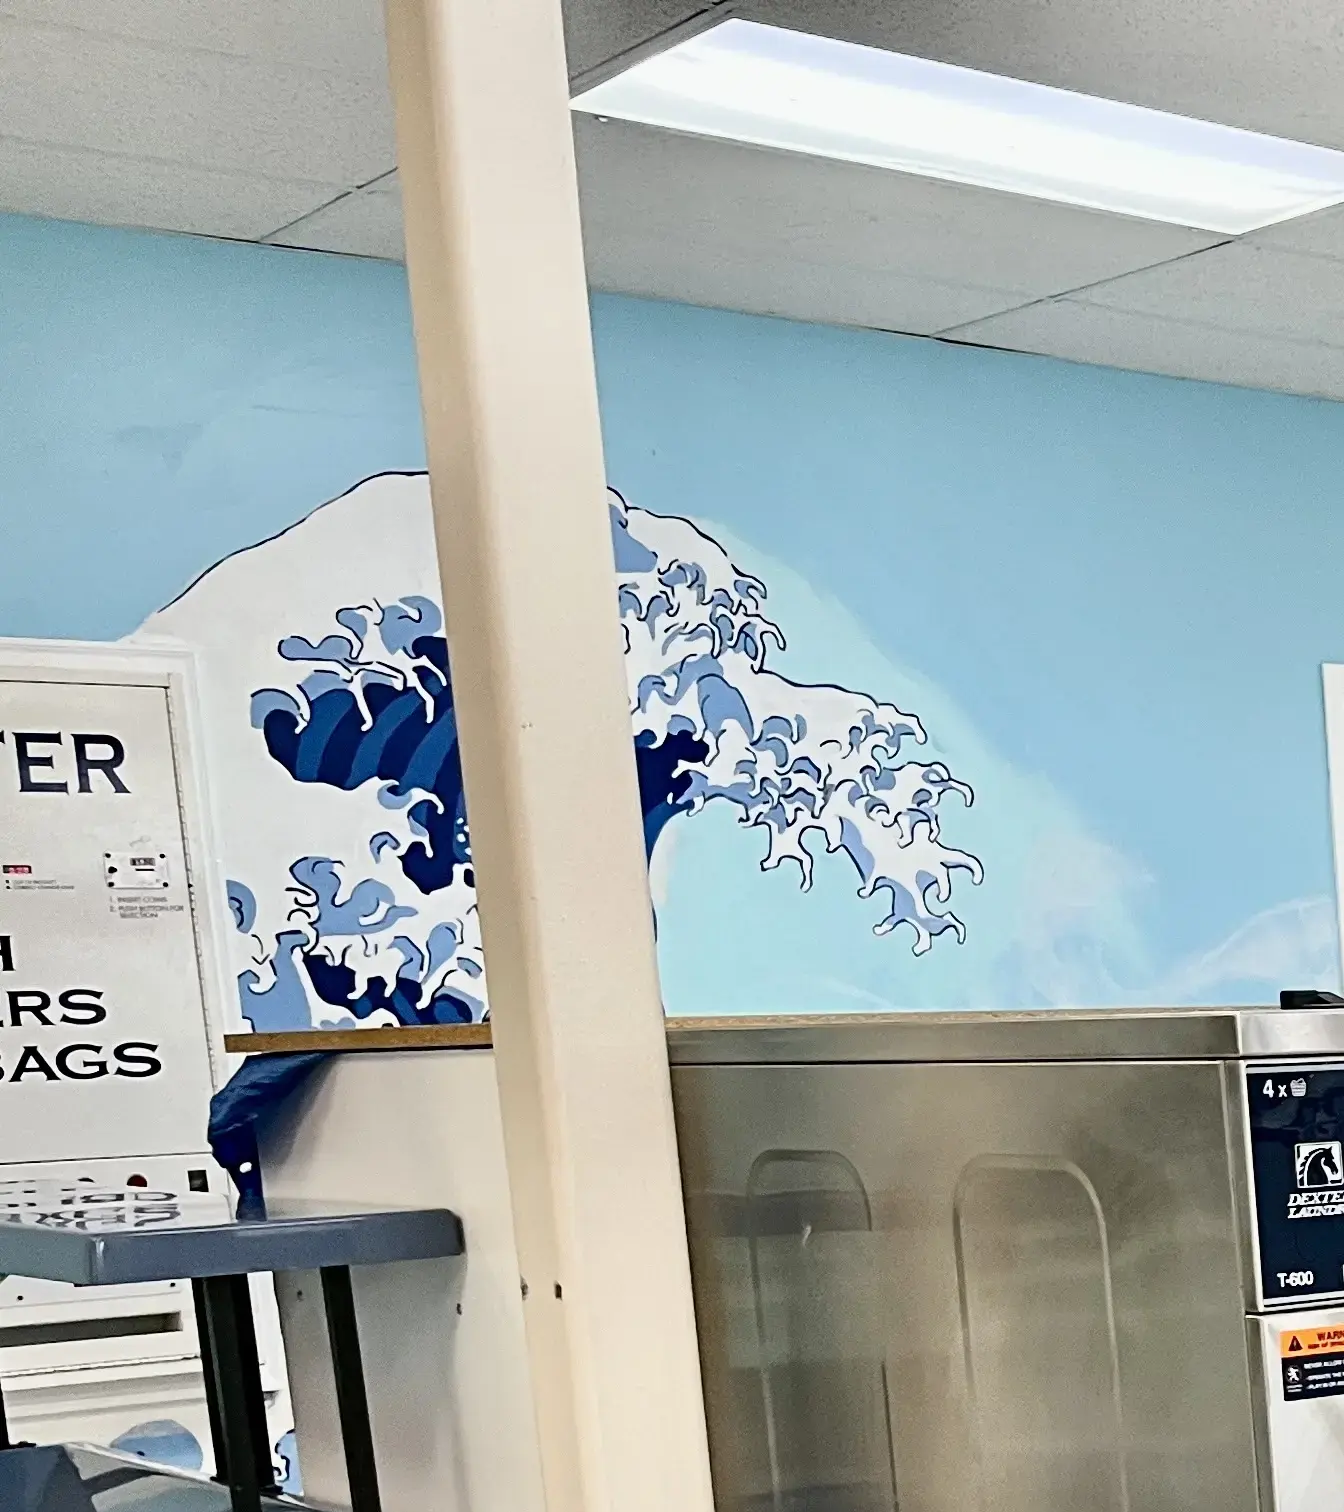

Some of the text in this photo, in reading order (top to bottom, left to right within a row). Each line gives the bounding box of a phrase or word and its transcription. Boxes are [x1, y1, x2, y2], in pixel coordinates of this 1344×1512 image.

[0, 730, 131, 795] ER
[0, 989, 107, 1028] RS
[0, 1041, 162, 1083] AGS
[1262, 1079, 1275, 1098] 4
[1276, 1270, 1314, 1287] T-600
